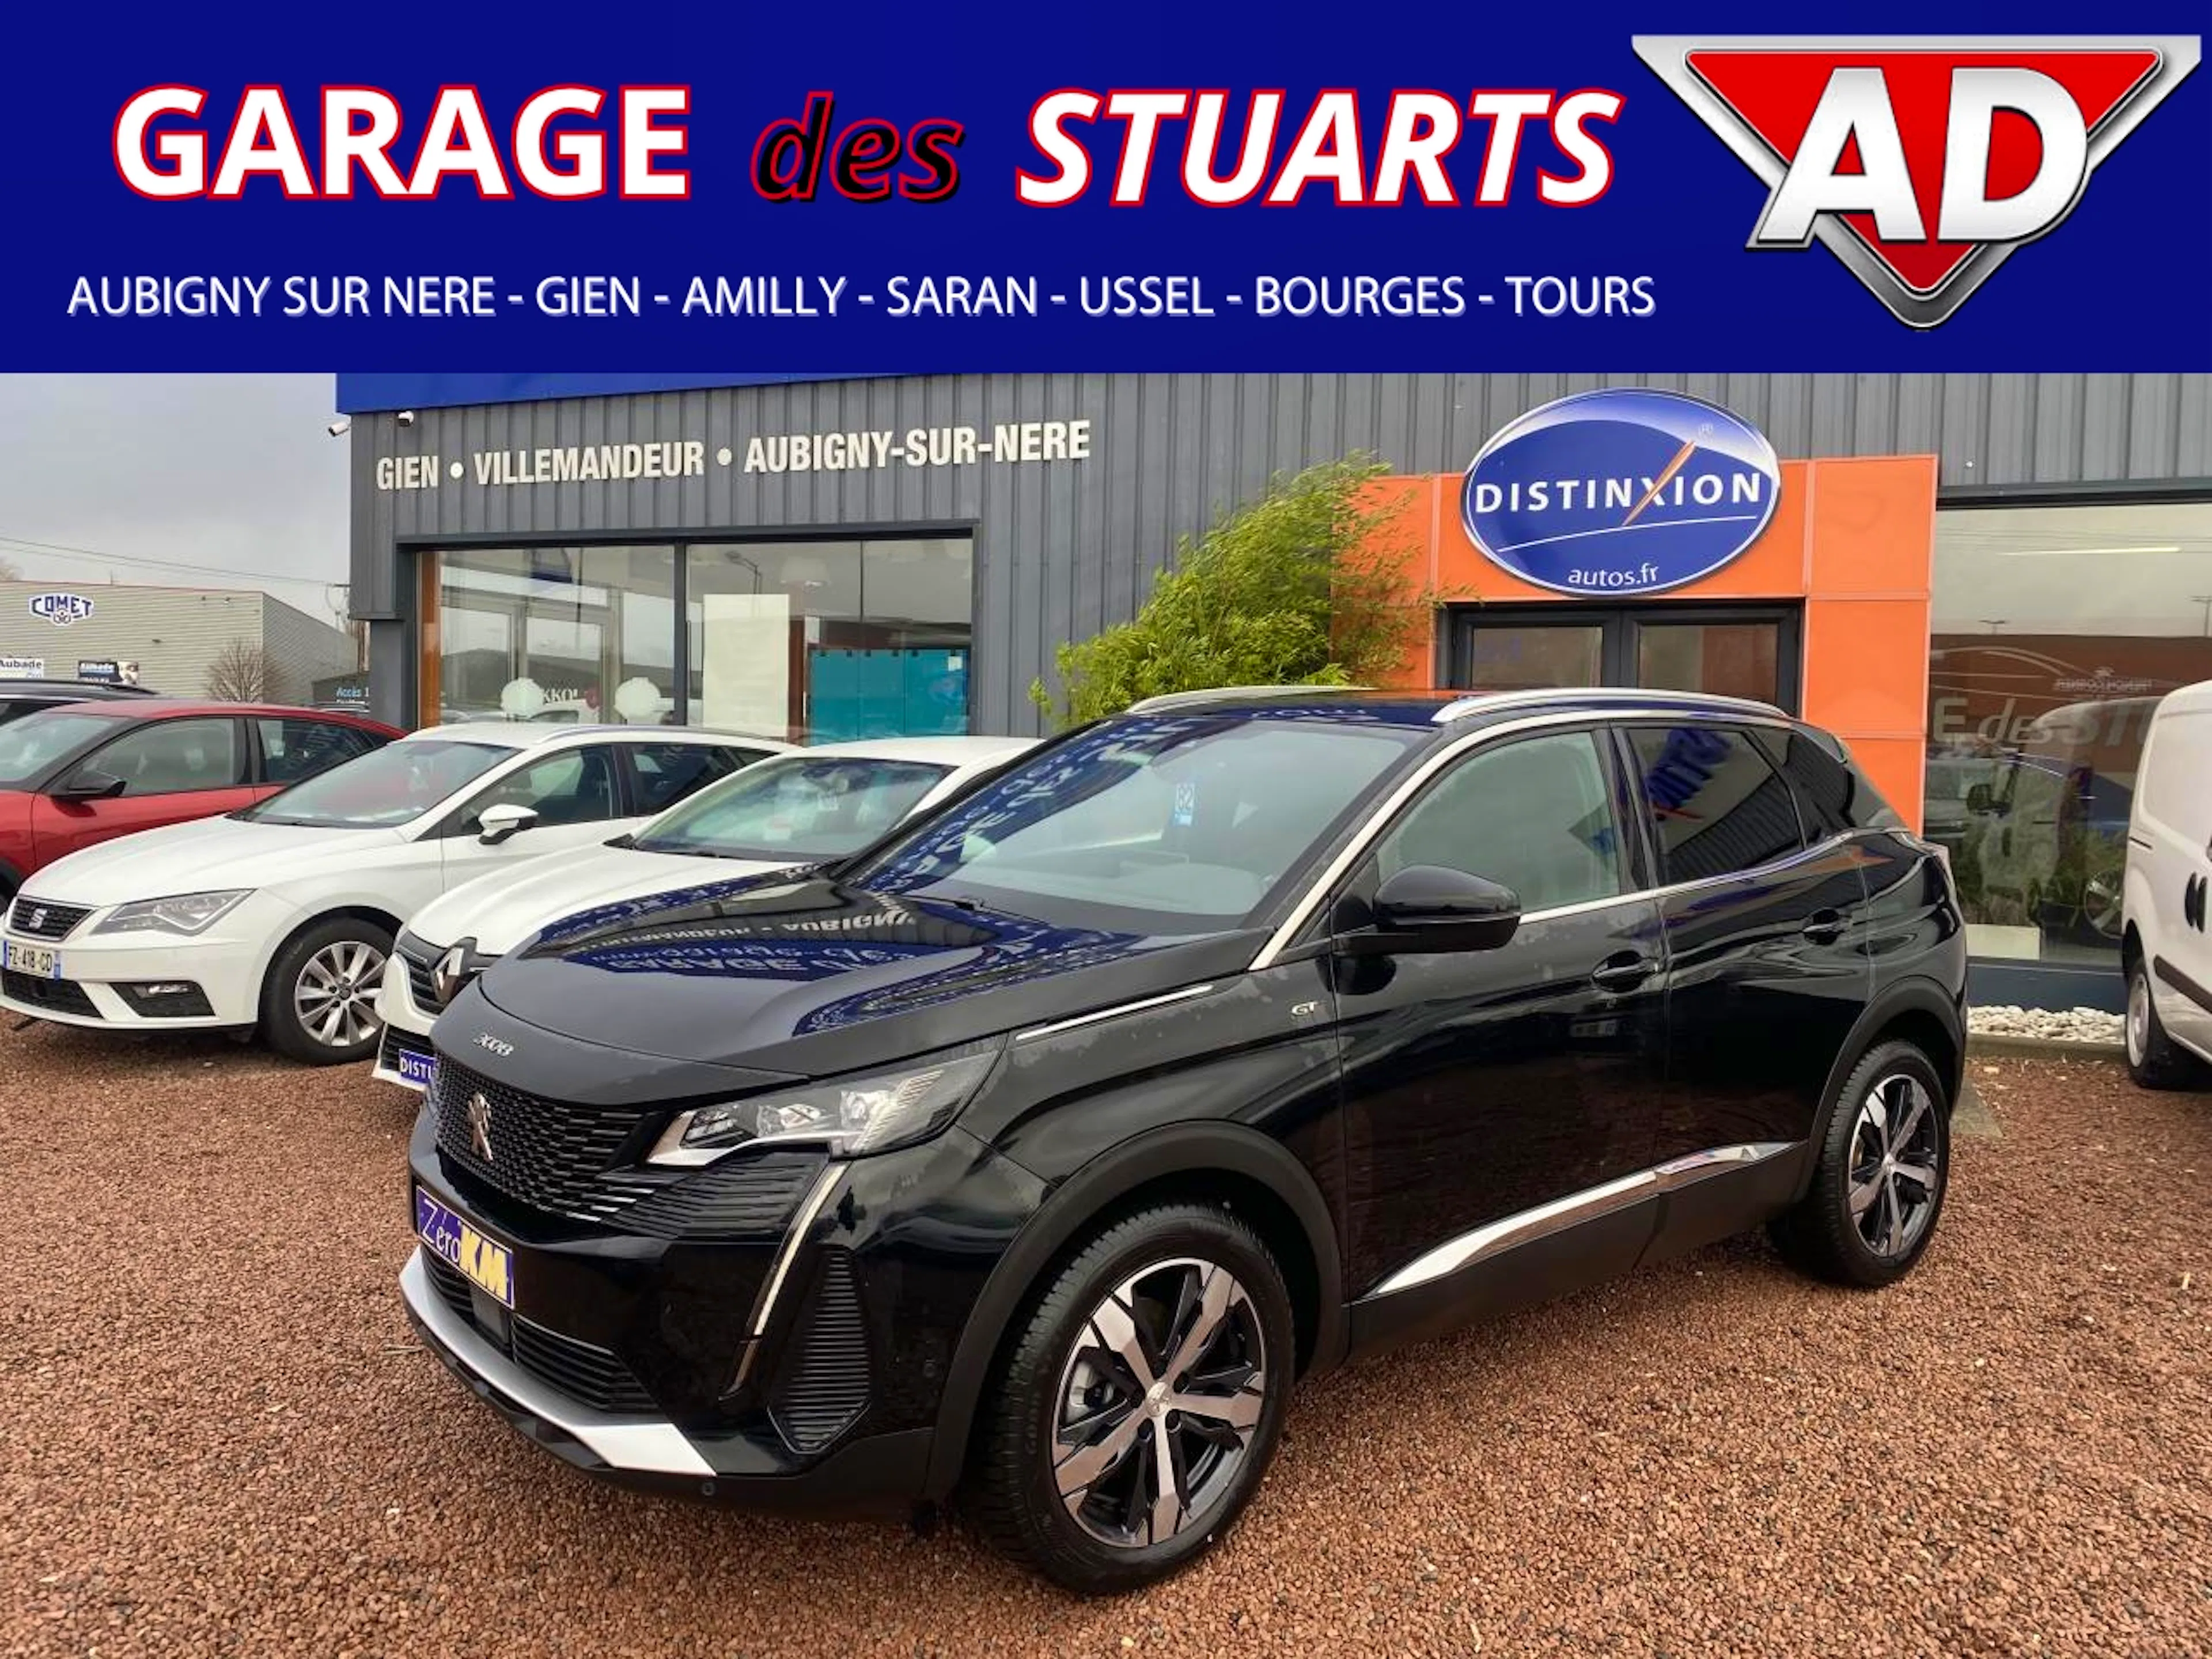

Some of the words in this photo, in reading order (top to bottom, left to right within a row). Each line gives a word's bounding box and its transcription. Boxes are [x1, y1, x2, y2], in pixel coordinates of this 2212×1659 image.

[377, 456, 438, 490] GIEN
[474, 441, 704, 485] VILLEMANDEUR
[744, 420, 1090, 473] AUBIGNY-SUR-NERE
[1475, 471, 1762, 514] DISTINXION
[1567, 562, 1659, 586] autos.fr
[32, 595, 92, 618] COMET
[1291, 1001, 1318, 1015] GT
[400, 1056, 432, 1080] DISTI
[460, 1222, 509, 1302] KM
